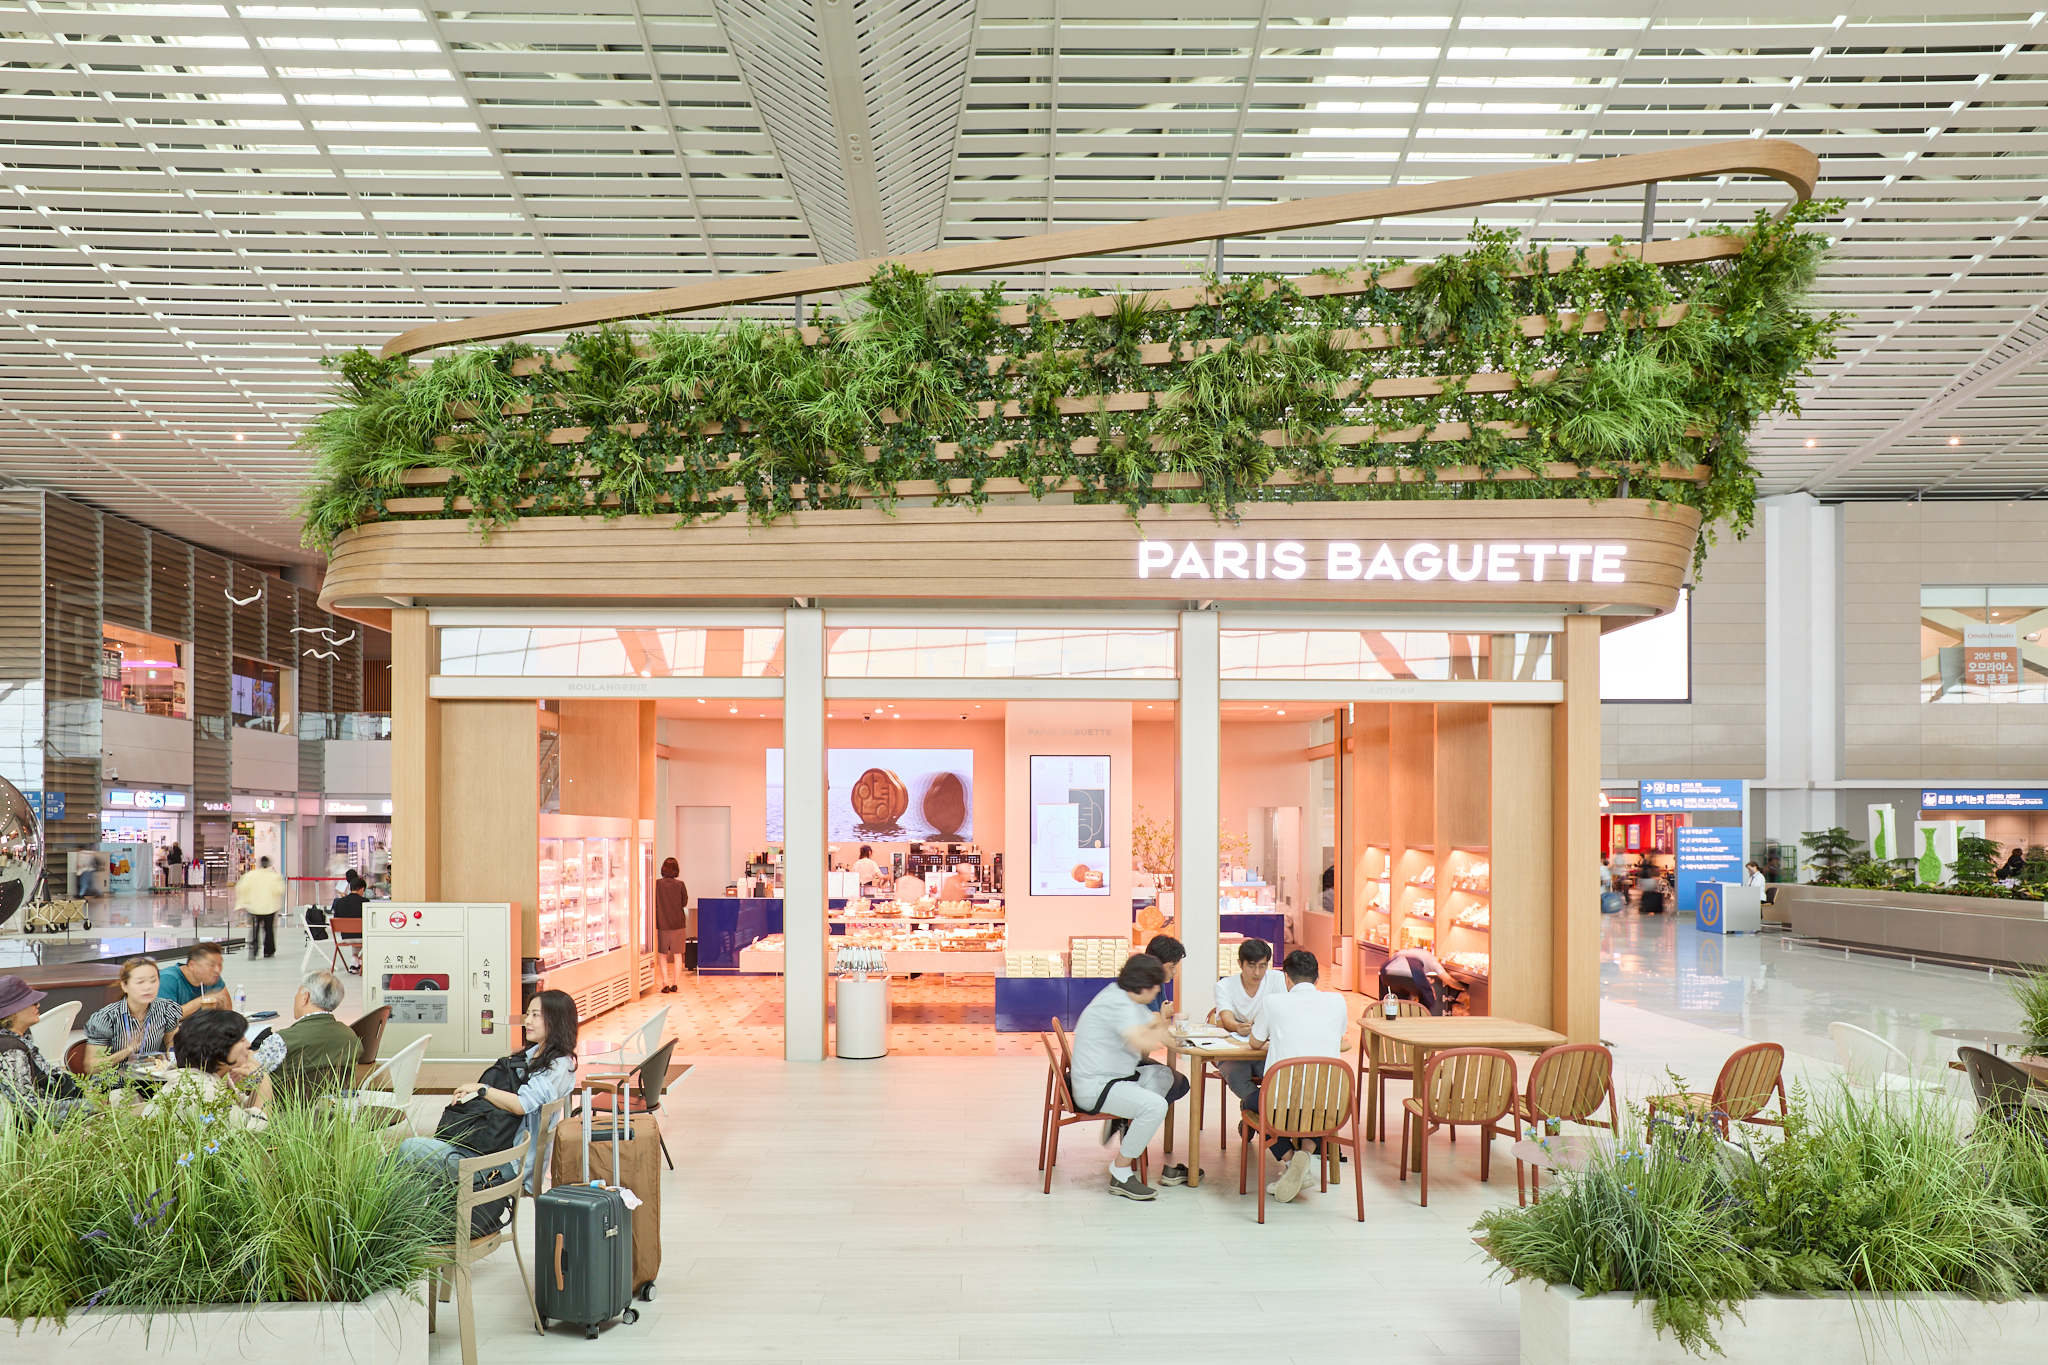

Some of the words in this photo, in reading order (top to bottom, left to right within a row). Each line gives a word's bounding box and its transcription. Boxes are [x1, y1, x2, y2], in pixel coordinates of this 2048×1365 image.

[1138, 541, 1306, 580] PARIS
[1326, 543, 1628, 583] BAGUETTE
[1974, 652, 1990, 660] 20년
[1992, 652, 2008, 660] 전통
[1967, 662, 2015, 673] 오므라이스
[1974, 673, 2009, 685] 전문점
[568, 683, 648, 692] BOULANGERIE
[1369, 687, 1415, 695] ARTISAN
[134, 791, 165, 809] GS25
